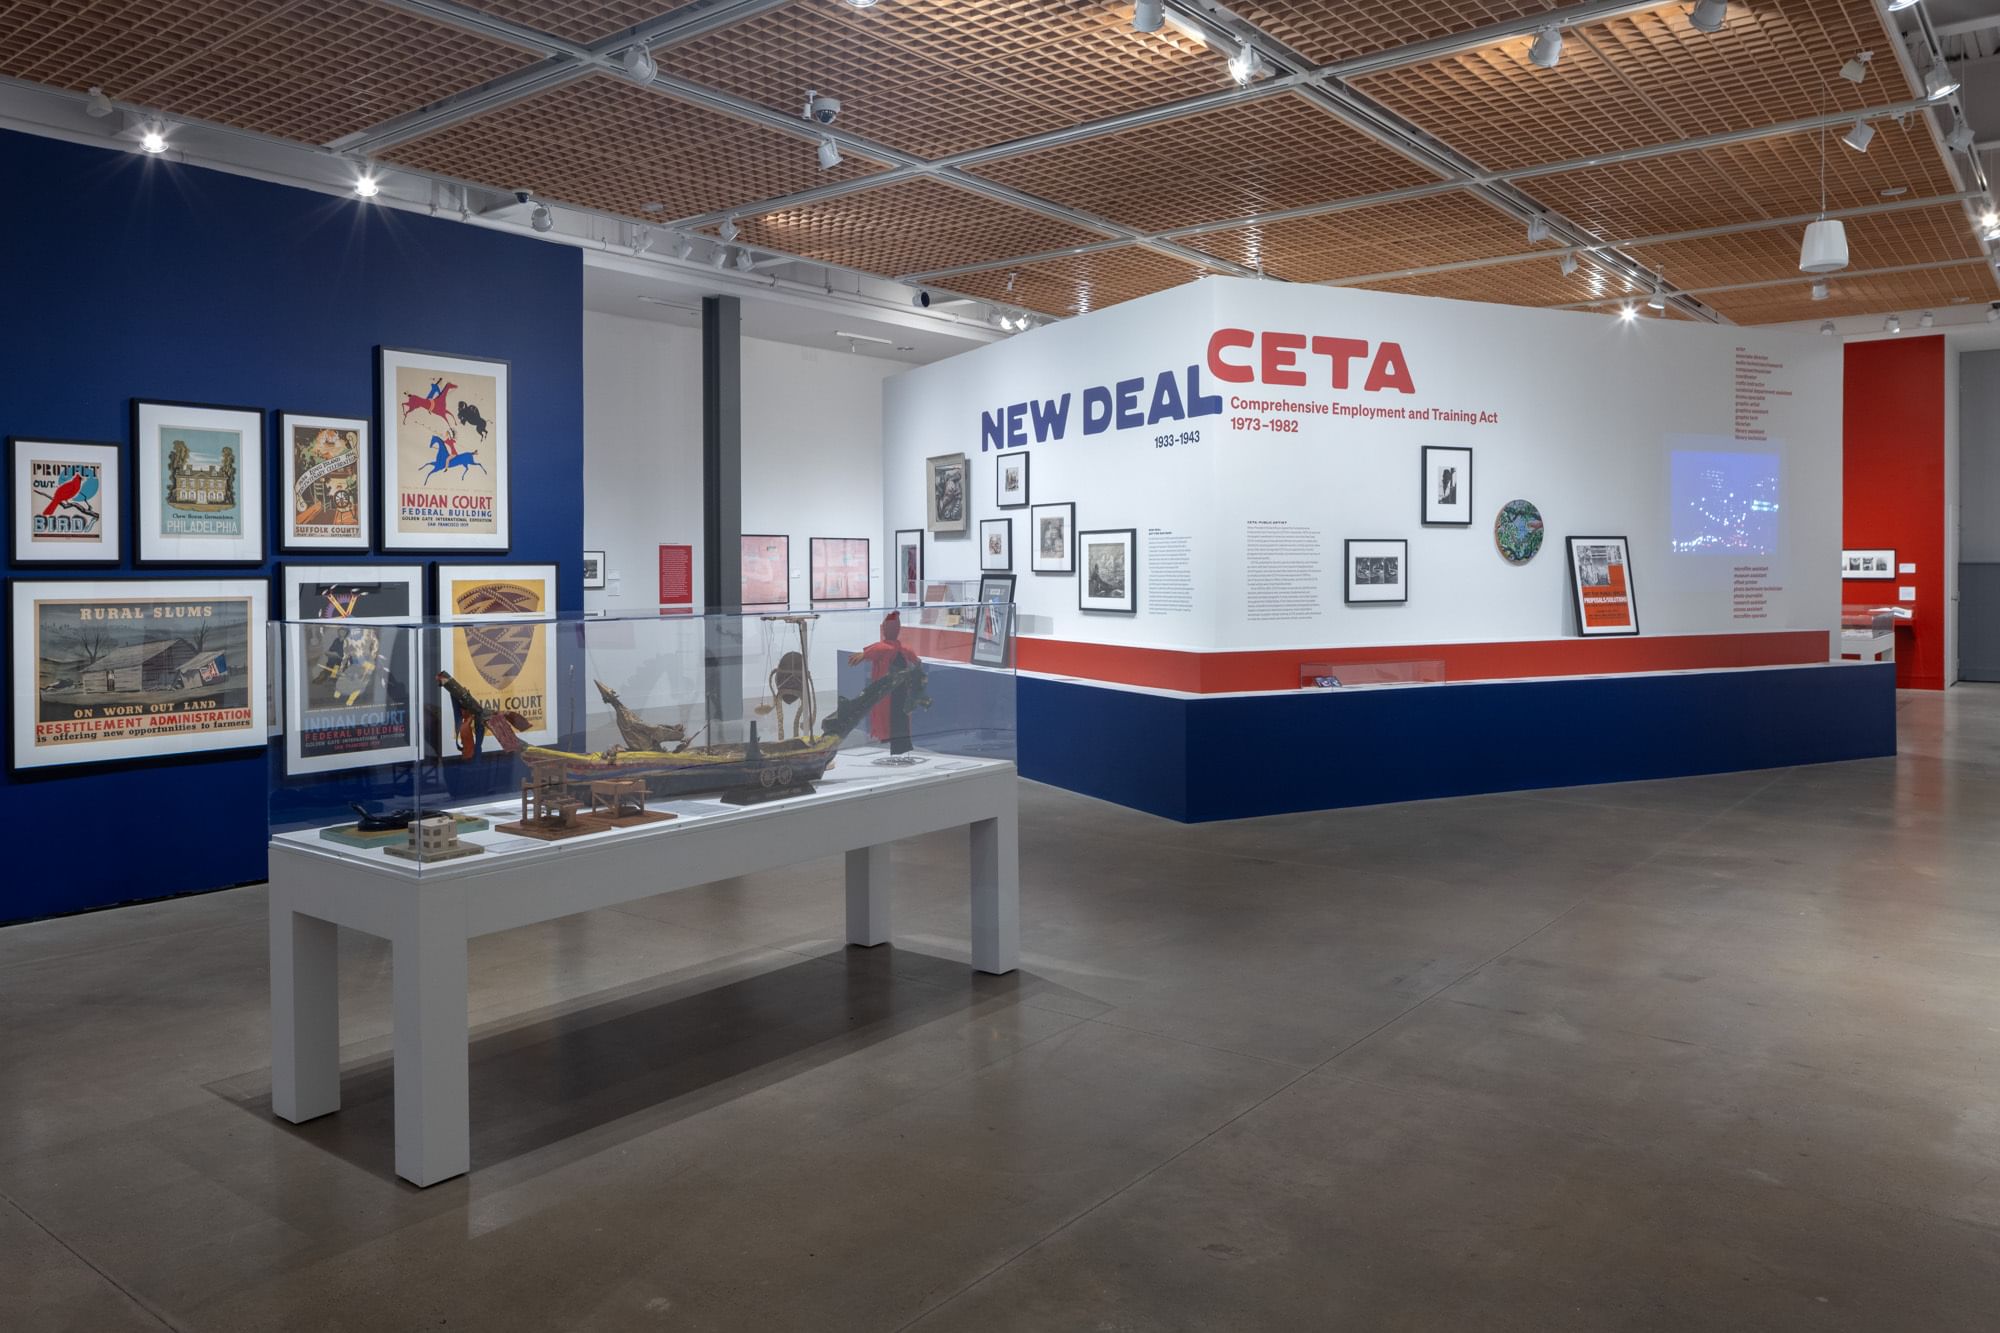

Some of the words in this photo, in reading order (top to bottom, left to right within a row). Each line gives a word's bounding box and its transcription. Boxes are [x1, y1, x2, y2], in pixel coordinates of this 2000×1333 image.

[1207, 328, 1415, 394] CETA
[982, 393, 1071, 452] NEW
[1083, 364, 1223, 436] DEAL
[1231, 396, 1329, 415] Comprehensive
[1332, 402, 1406, 420] Employment
[1408, 407, 1429, 421] and
[1432, 408, 1477, 425] Training
[1479, 411, 1498, 424] Act
[1231, 418, 1299, 433] 1973–1982
[33, 463, 100, 478] PROTECT
[402, 493, 448, 509] INDIAN
[452, 495, 493, 510] COURT
[402, 508, 444, 516] FEDERAL
[449, 509, 492, 518] BUILDING
[167, 520, 238, 534] PHILADELPHIA
[296, 526, 328, 534] SUFFOLK
[331, 527, 360, 535] COUNTY
[80, 607, 145, 621] RURAL
[153, 605, 213, 619] SLUMS
[74, 708, 93, 719] ON
[104, 704, 144, 717] WORN
[150, 702, 175, 714] OUT
[184, 700, 217, 711] LAND
[480, 697, 500, 711] IAN
[504, 694, 543, 710] COURT
[36, 717, 144, 736] RESETTLEMENT
[150, 708, 252, 727] ADMINISTRATION
[304, 714, 356, 732] INDIAN
[361, 709, 406, 727] COURT
[36, 735, 47, 743] is
[52, 730, 98, 743] offering
[103, 728, 125, 738] new
[128, 722, 197, 737] opportunities
[201, 722, 211, 730] to
[213, 719, 251, 728] farmers
[304, 730, 353, 742] FEDERAL
[356, 724, 406, 737] BUILDING
